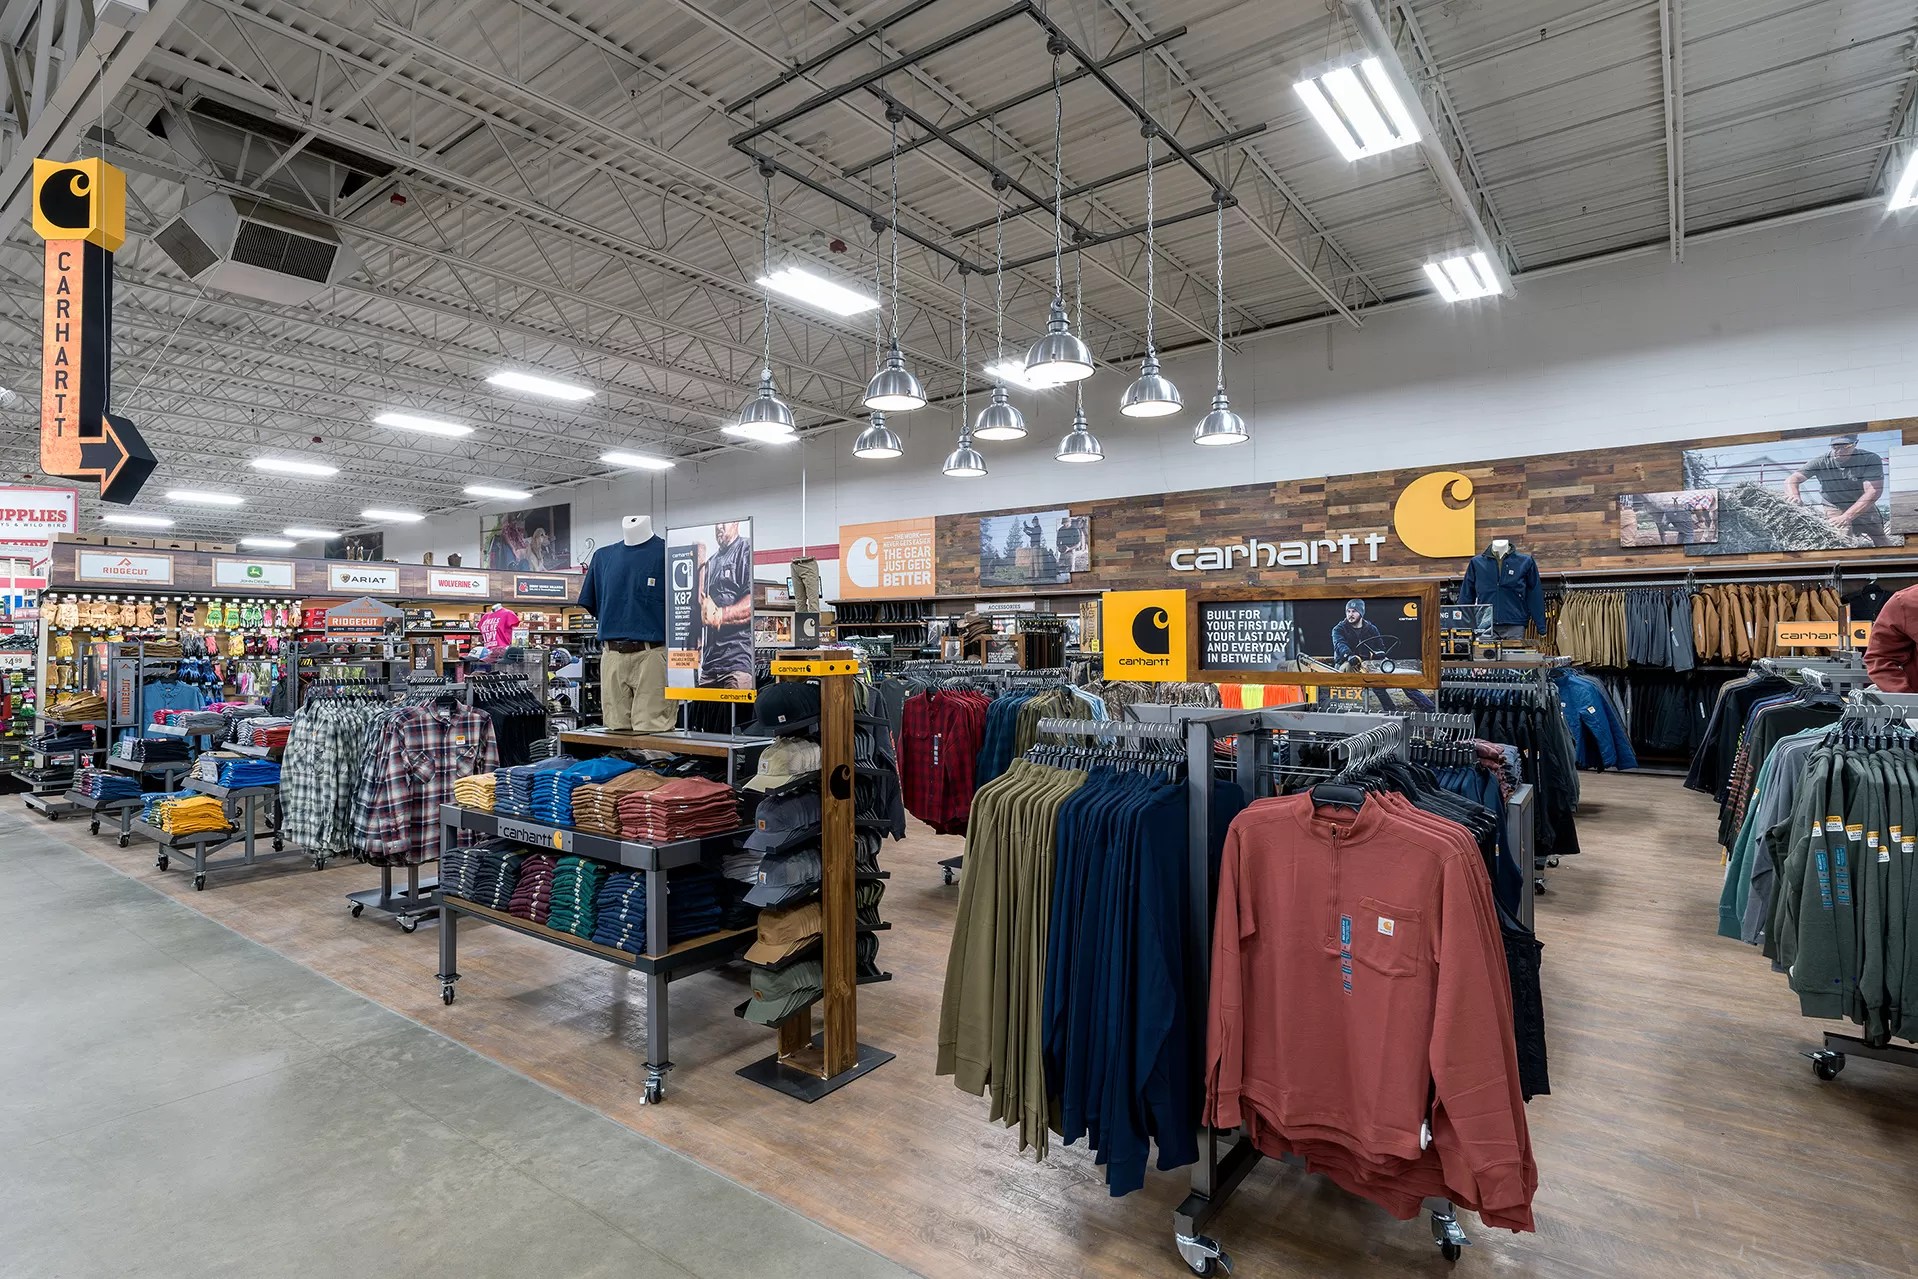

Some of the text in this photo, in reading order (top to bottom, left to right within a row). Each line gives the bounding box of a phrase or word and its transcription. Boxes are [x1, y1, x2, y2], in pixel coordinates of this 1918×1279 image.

[54, 251, 71, 437] CARHARTT
[913, 537, 931, 545] EASIER
[884, 546, 931, 560] THE GEAR
[1169, 532, 1387, 571] carhartt
[884, 558, 931, 572] JUST GETS
[102, 567, 148, 575] RIDGECUT
[351, 576, 386, 584] ARIAT
[884, 571, 931, 586] BETTER
[438, 580, 471, 588] WOLVERINE
[674, 592, 691, 604] K87
[1207, 610, 1260, 620] BUILT FOR
[332, 618, 378, 626] RIDGECUT
[1207, 620, 1294, 631] YOUR FIRST DAY,
[1207, 632, 1290, 642] YOUR LAST DAY,
[1780, 632, 1838, 640] carhar
[1207, 643, 1287, 652] AND EVERYDAY
[1119, 657, 1170, 666] carhartt
[1207, 653, 1272, 663] IN BETWEEN
[122, 679, 130, 715] RIDGECUT
[720, 693, 747, 701] carhartt
[1330, 689, 1363, 701] FLEX
[503, 826, 552, 846] carhartt
